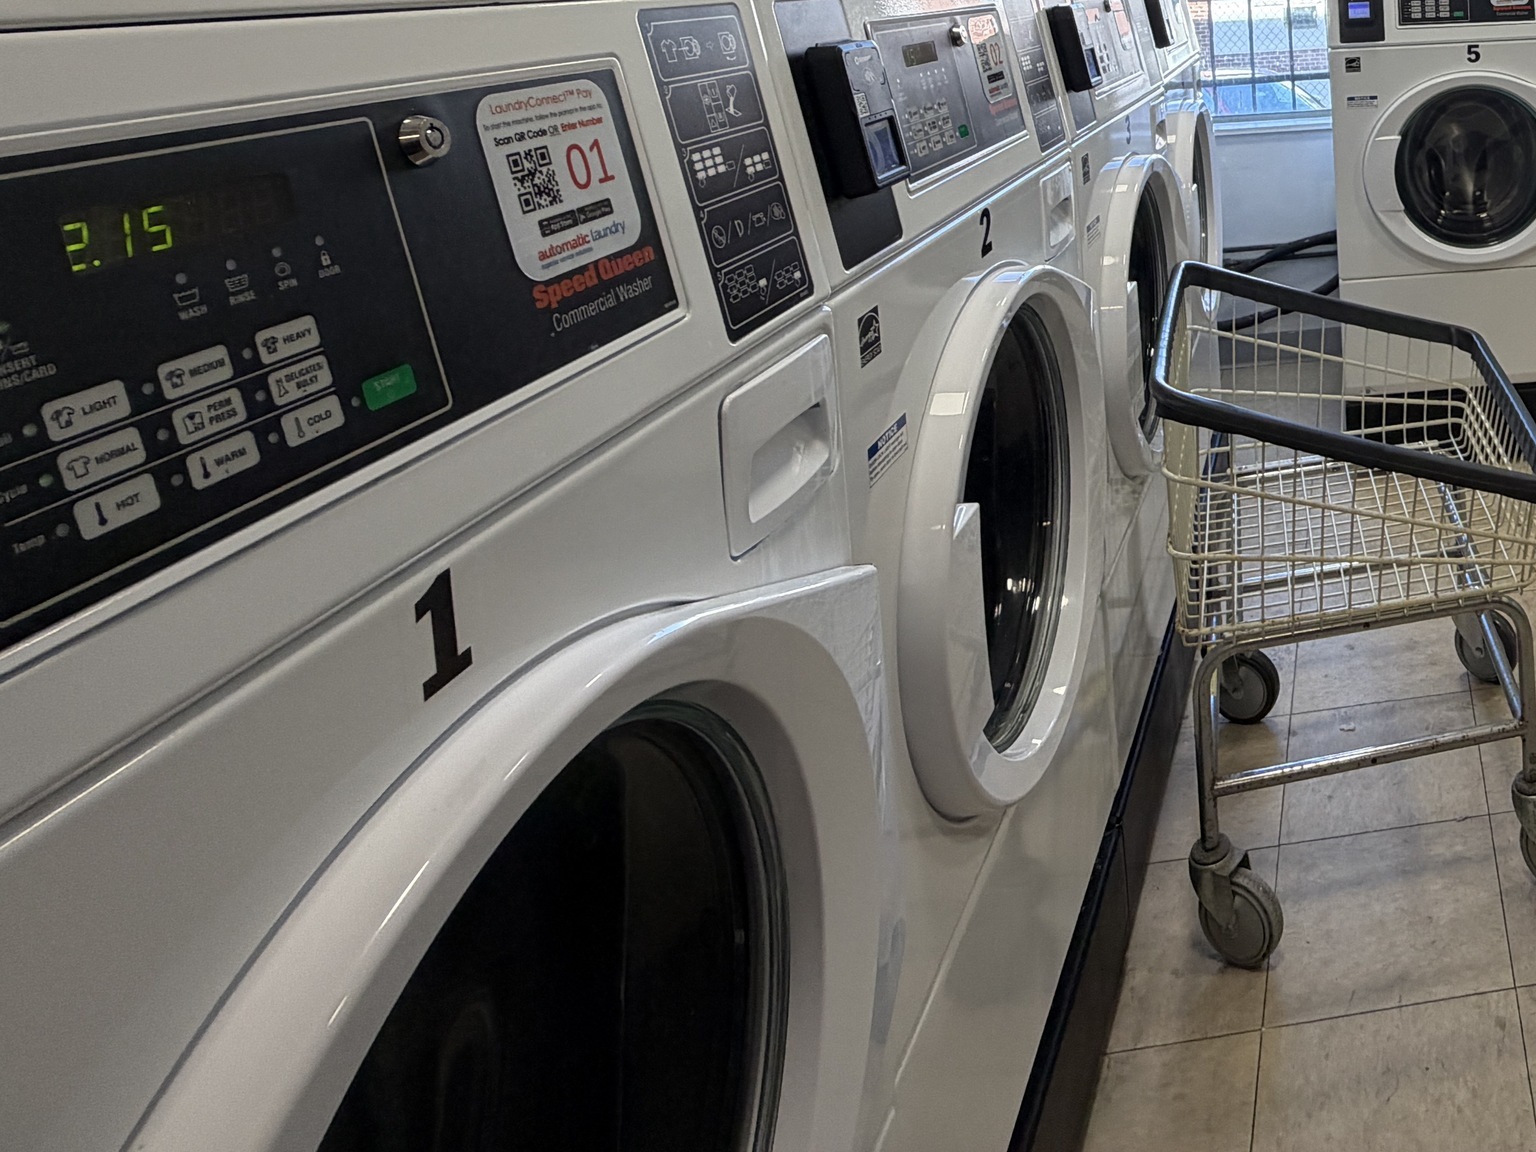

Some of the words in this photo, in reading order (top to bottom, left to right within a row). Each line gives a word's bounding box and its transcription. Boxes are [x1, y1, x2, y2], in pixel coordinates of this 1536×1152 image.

[990, 42, 1003, 66] 02
[1466, 44, 1481, 63] 5
[575, 88, 593, 100] Pay
[493, 134, 514, 147] Scan
[514, 131, 526, 142] QR
[526, 127, 548, 140] Code
[560, 121, 578, 133] Enter
[577, 117, 603, 129] Number
[565, 138, 616, 190] 01
[63, 205, 173, 273] 2.15
[537, 234, 591, 262] automatic
[590, 220, 625, 242] laundry
[979, 207, 993, 259] 2
[277, 278, 298, 291] SPIN
[532, 266, 598, 310] Speed
[598, 245, 655, 281] Queen
[177, 304, 208, 321] WASH
[553, 288, 618, 333] Commercial
[618, 275, 653, 308] Washer
[282, 327, 313, 345] HEAVY
[188, 357, 226, 379] MEDIUM
[81, 394, 119, 416] LIGHT
[206, 397, 233, 413] PERM
[208, 408, 238, 426] PRESS
[306, 409, 333, 427] COLD
[876, 422, 898, 449] NOTICE
[94, 442, 138, 465] NORMAL
[213, 446, 248, 468] WARM
[115, 491, 141, 512] HOT
[414, 567, 473, 702] 1
